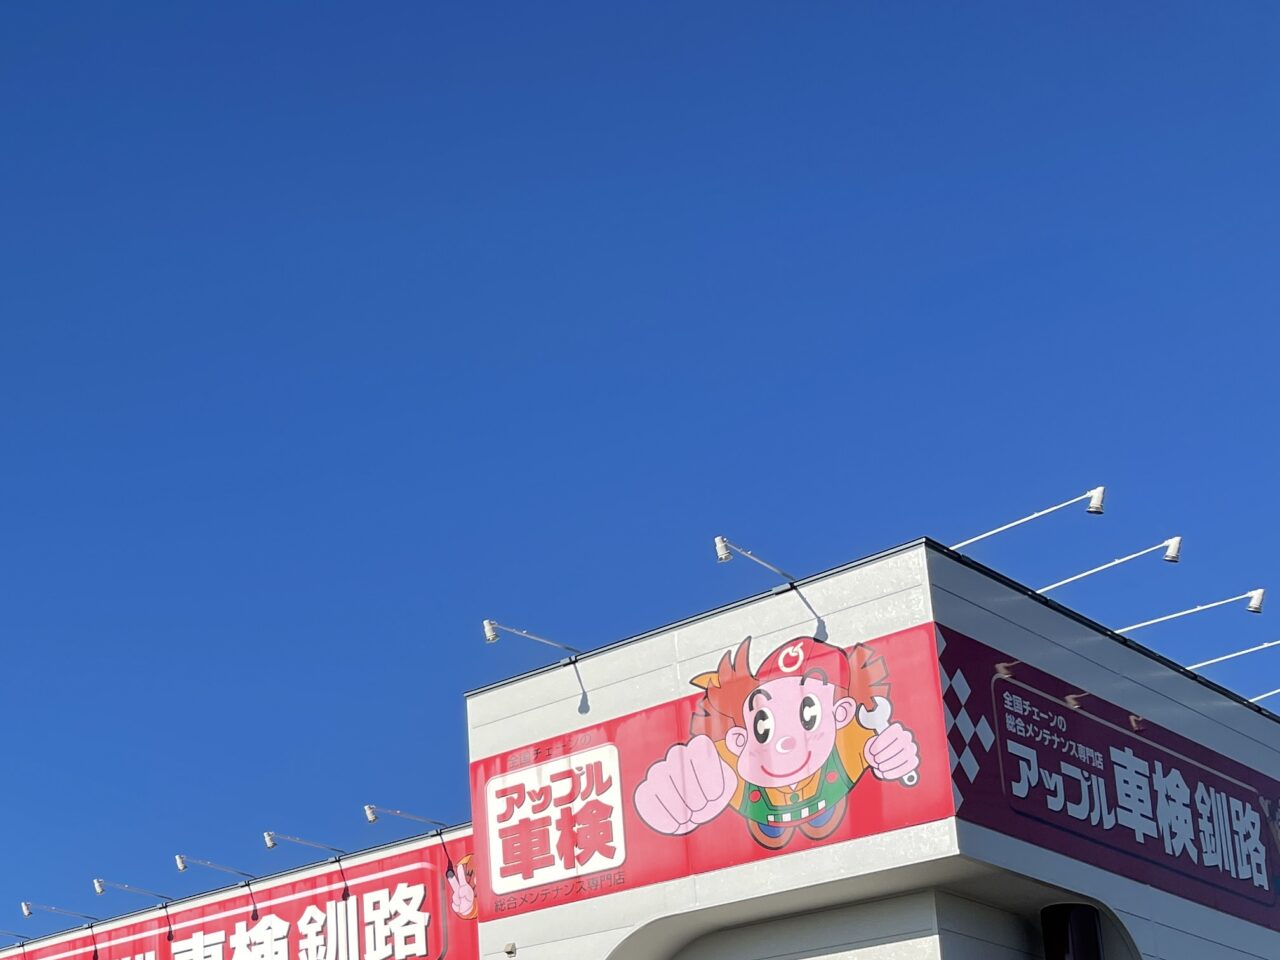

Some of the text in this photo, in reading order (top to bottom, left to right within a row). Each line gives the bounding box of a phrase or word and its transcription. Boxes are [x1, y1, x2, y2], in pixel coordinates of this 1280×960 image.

[1002, 691, 1067, 732] 全国チェーンの
[1005, 713, 1104, 771] 総合メンテナンス専門店
[495, 761, 613, 823] アップル
[498, 799, 617, 880] 車検
[494, 872, 626, 913] 総合メンテナンス専門店
